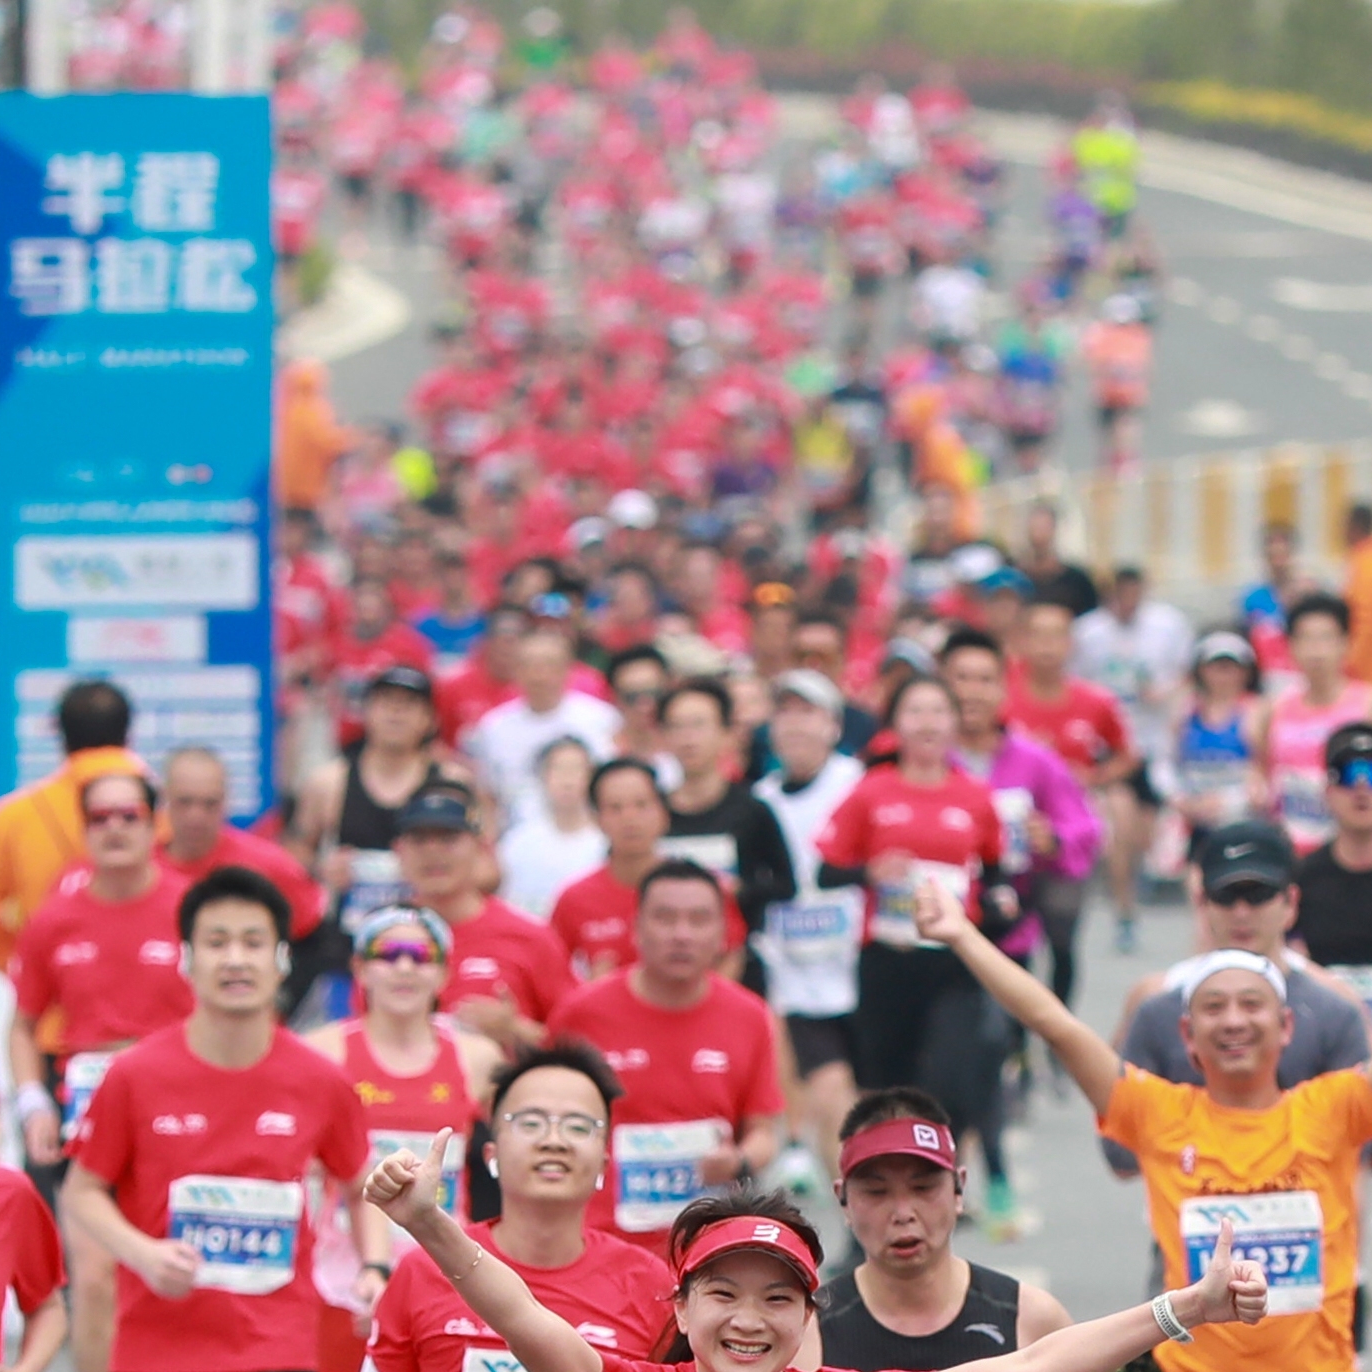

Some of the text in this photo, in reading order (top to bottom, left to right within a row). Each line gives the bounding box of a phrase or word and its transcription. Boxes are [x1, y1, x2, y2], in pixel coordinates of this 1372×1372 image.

[41, 152, 220, 233] 半程
[9, 237, 258, 315] 马拉松
